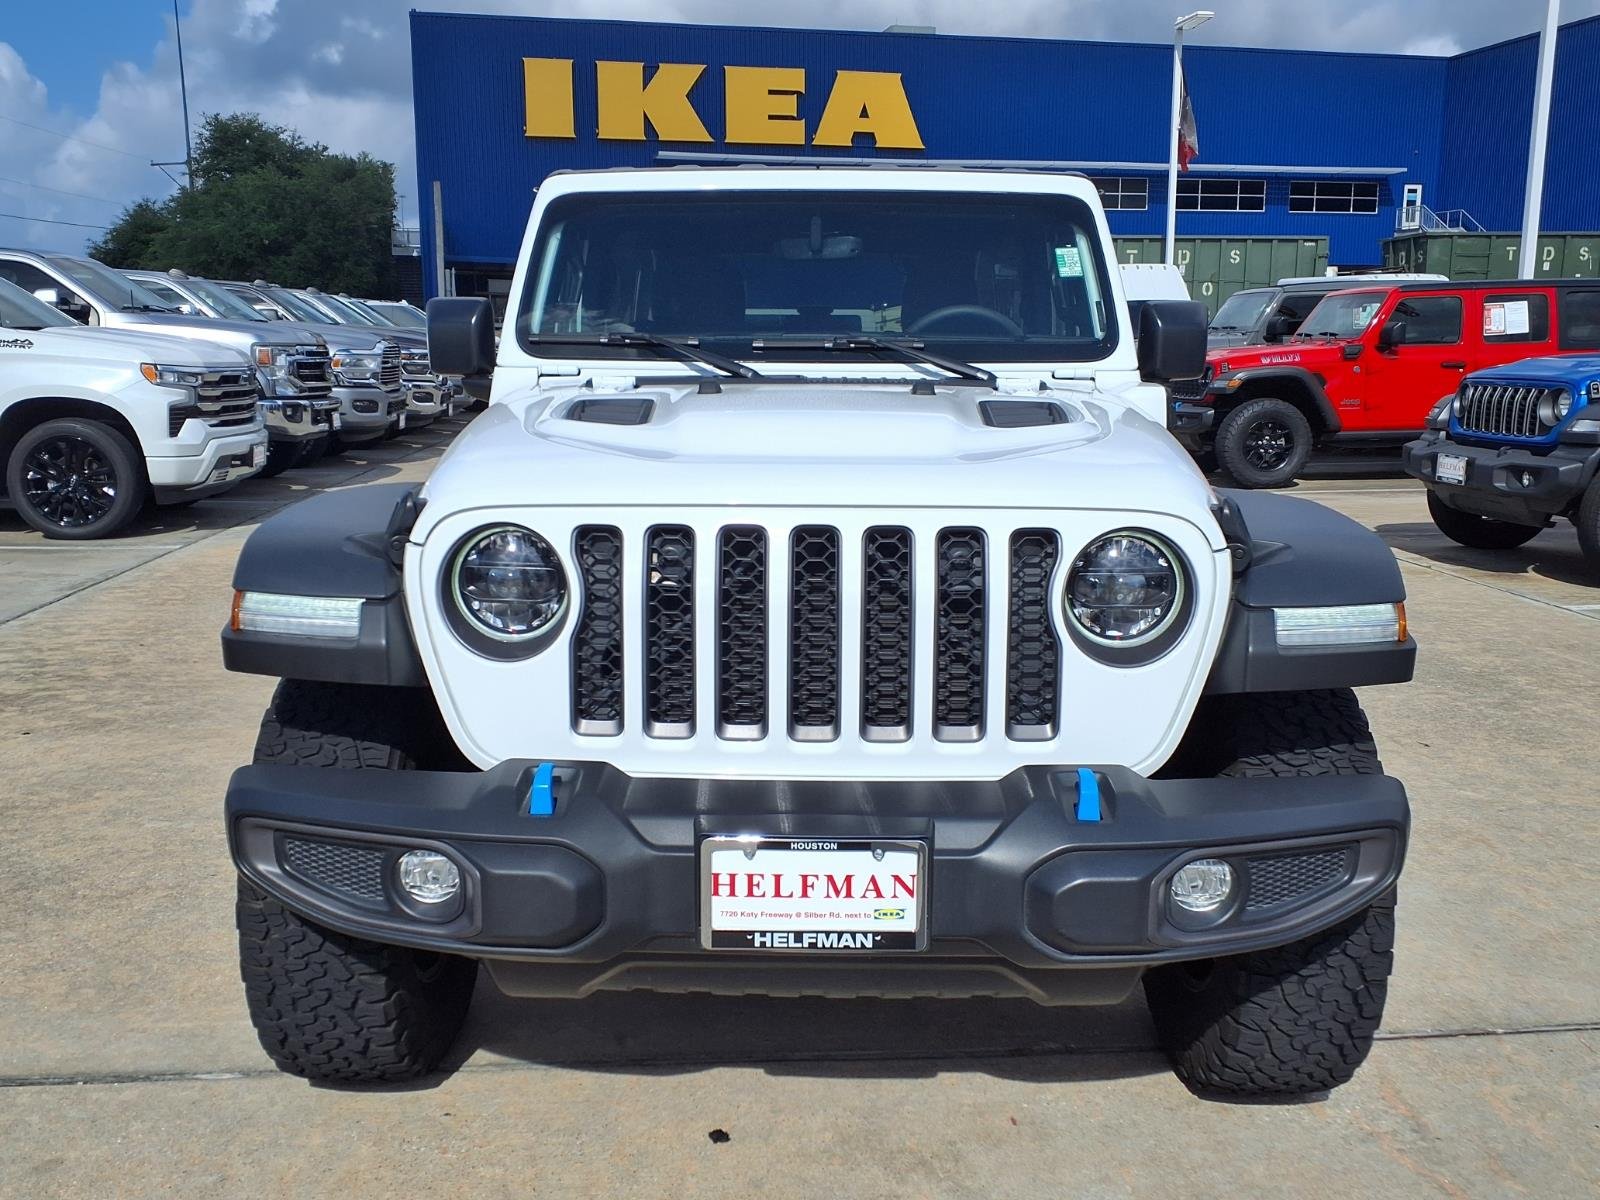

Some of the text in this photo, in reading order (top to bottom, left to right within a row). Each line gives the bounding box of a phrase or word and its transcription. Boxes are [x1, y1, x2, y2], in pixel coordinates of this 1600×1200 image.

[523, 57, 925, 149] IKEA
[790, 842, 837, 850] HOUSTON
[711, 872, 917, 899] HELFMAN
[740, 910, 758, 919] Katy
[760, 911, 793, 920] Freeway
[829, 911, 842, 919] Rd.
[864, 911, 872, 919] to
[754, 932, 873, 949] HELFMAN
